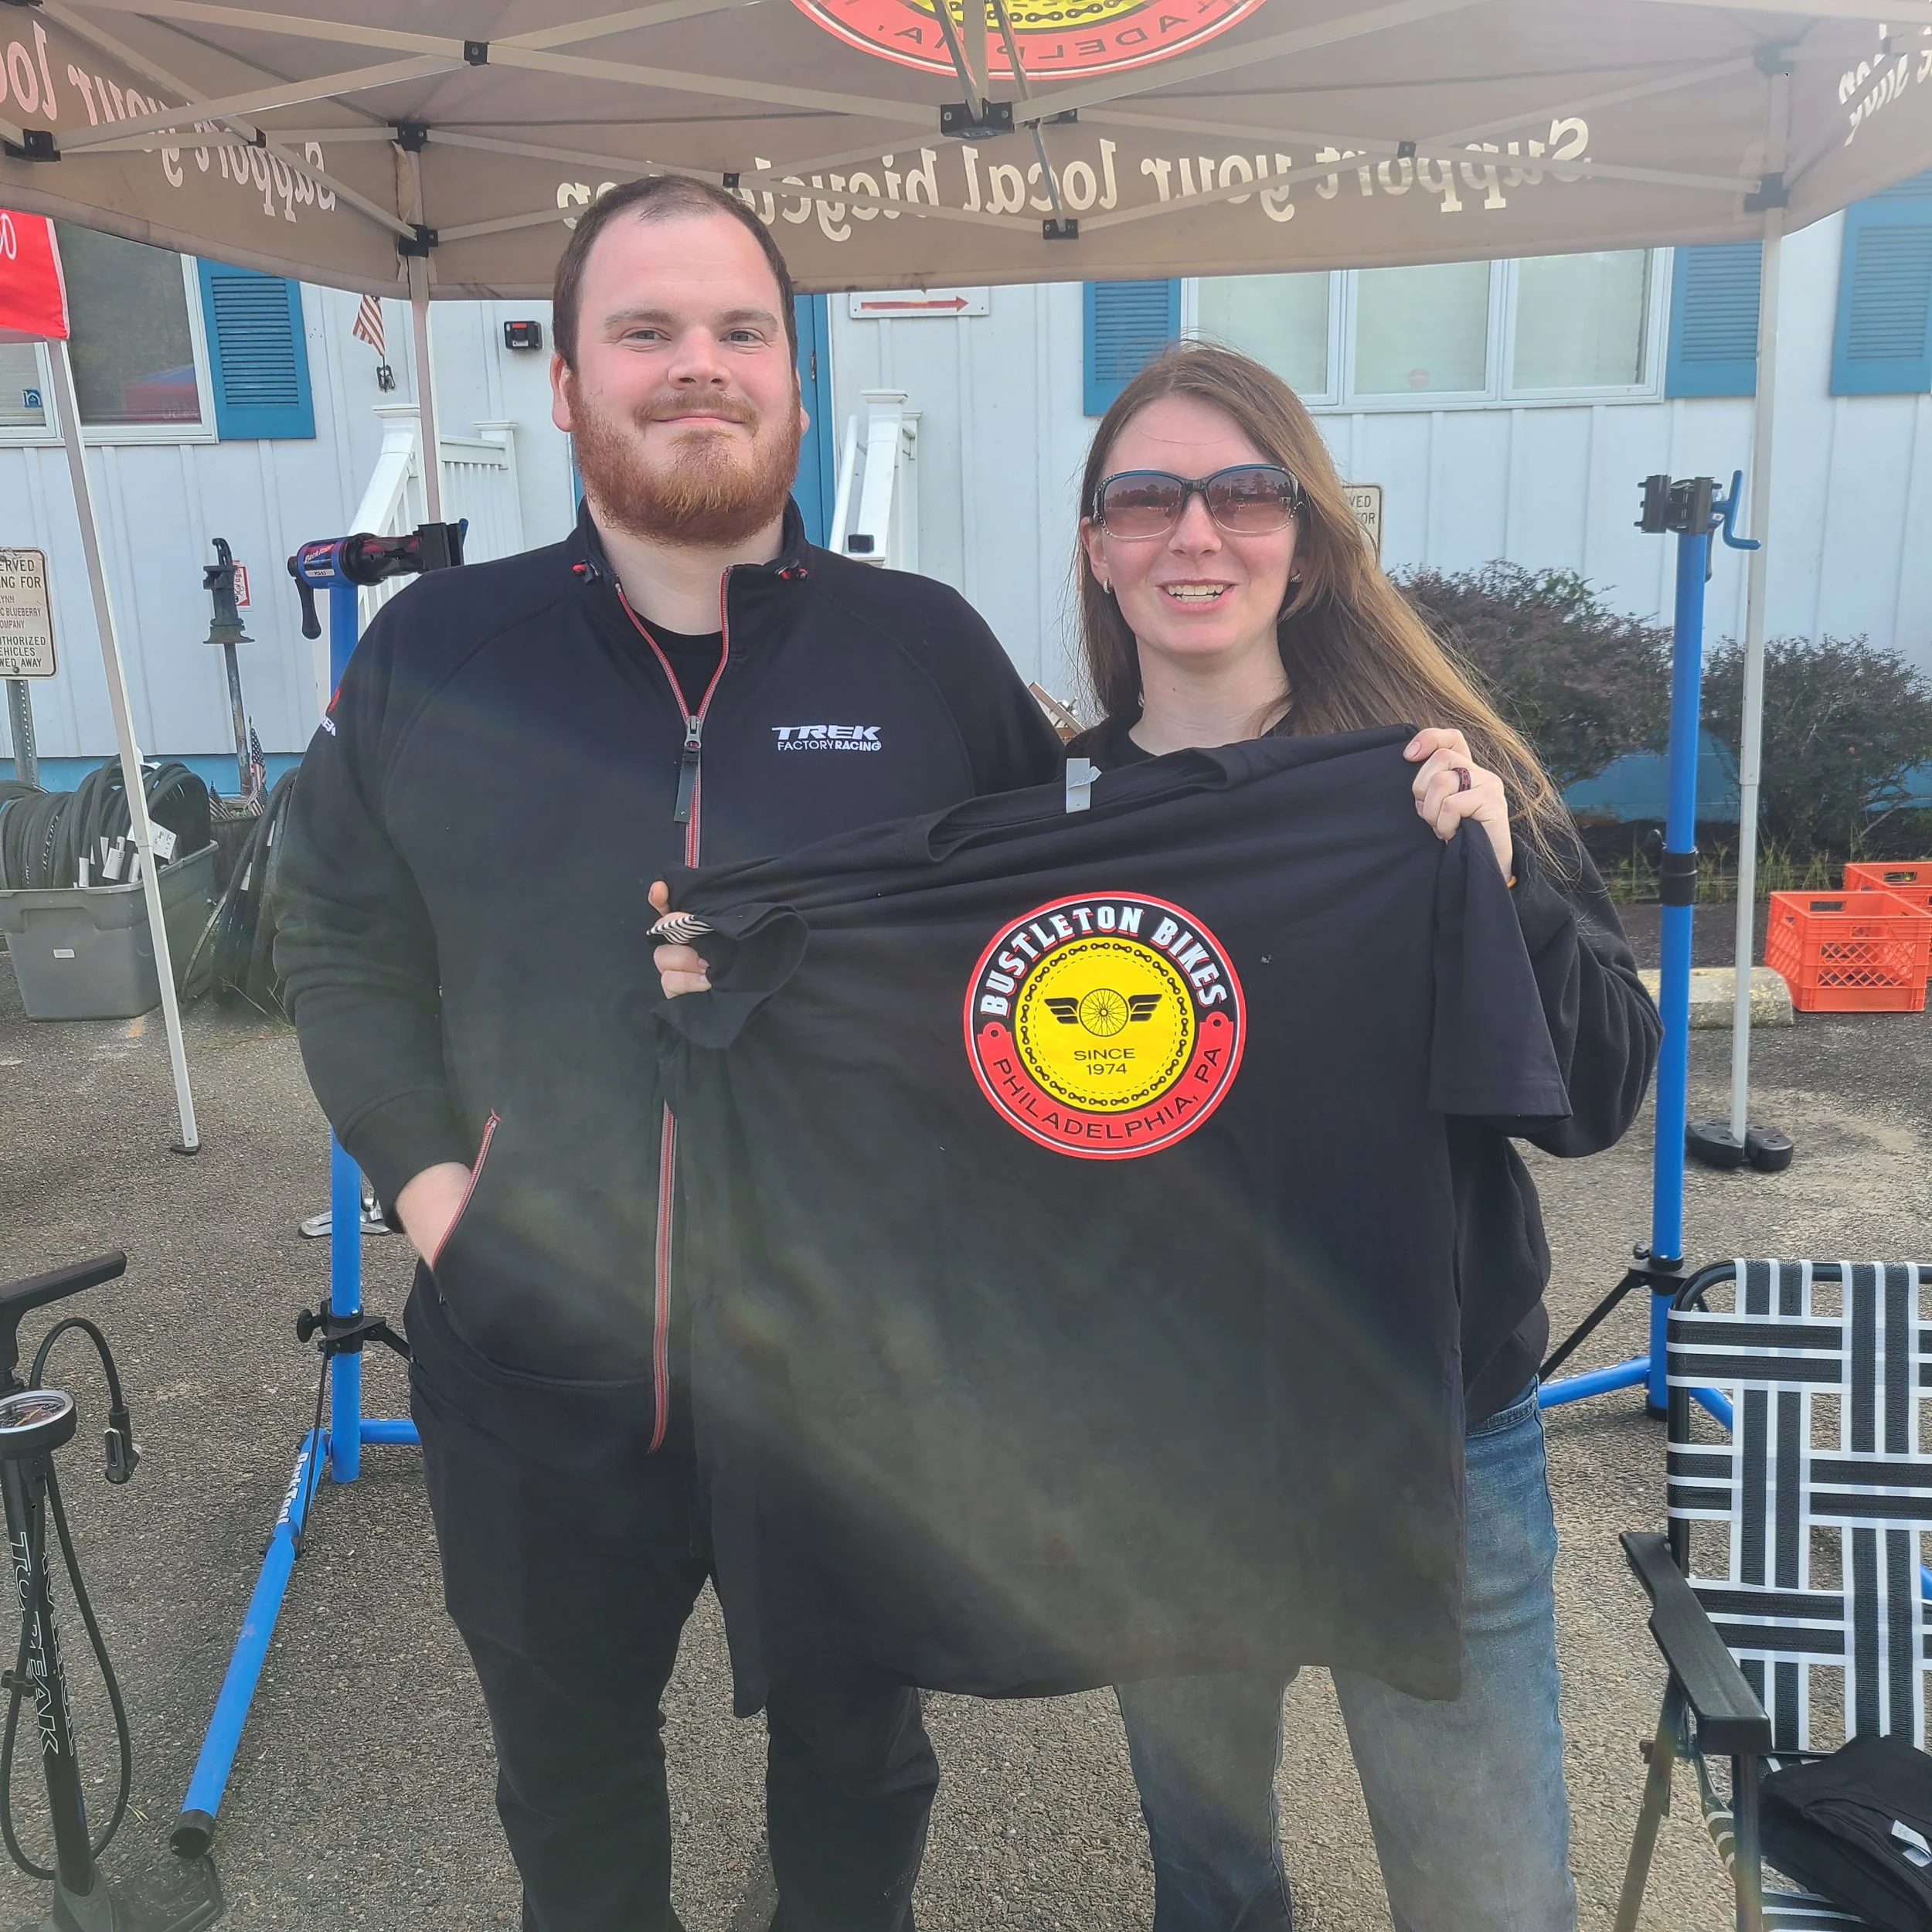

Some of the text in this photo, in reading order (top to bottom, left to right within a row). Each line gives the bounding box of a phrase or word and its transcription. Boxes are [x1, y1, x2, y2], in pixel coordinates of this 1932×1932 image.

[1356, 512, 1376, 524] OR
[20, 576, 42, 588] FOR
[0, 595, 15, 604] YNN
[5, 607, 42, 617] BLUEBERRY
[0, 636, 46, 646] THORIZED
[21, 658, 42, 668] AWAY
[771, 724, 882, 740] TREK
[980, 905, 1229, 1019] BUSTLETON BIKES
[1073, 1047, 1137, 1062] SINCE
[1085, 1063, 1128, 1077] 1974
[992, 1046, 1223, 1140] PHILADELPHIA, PA
